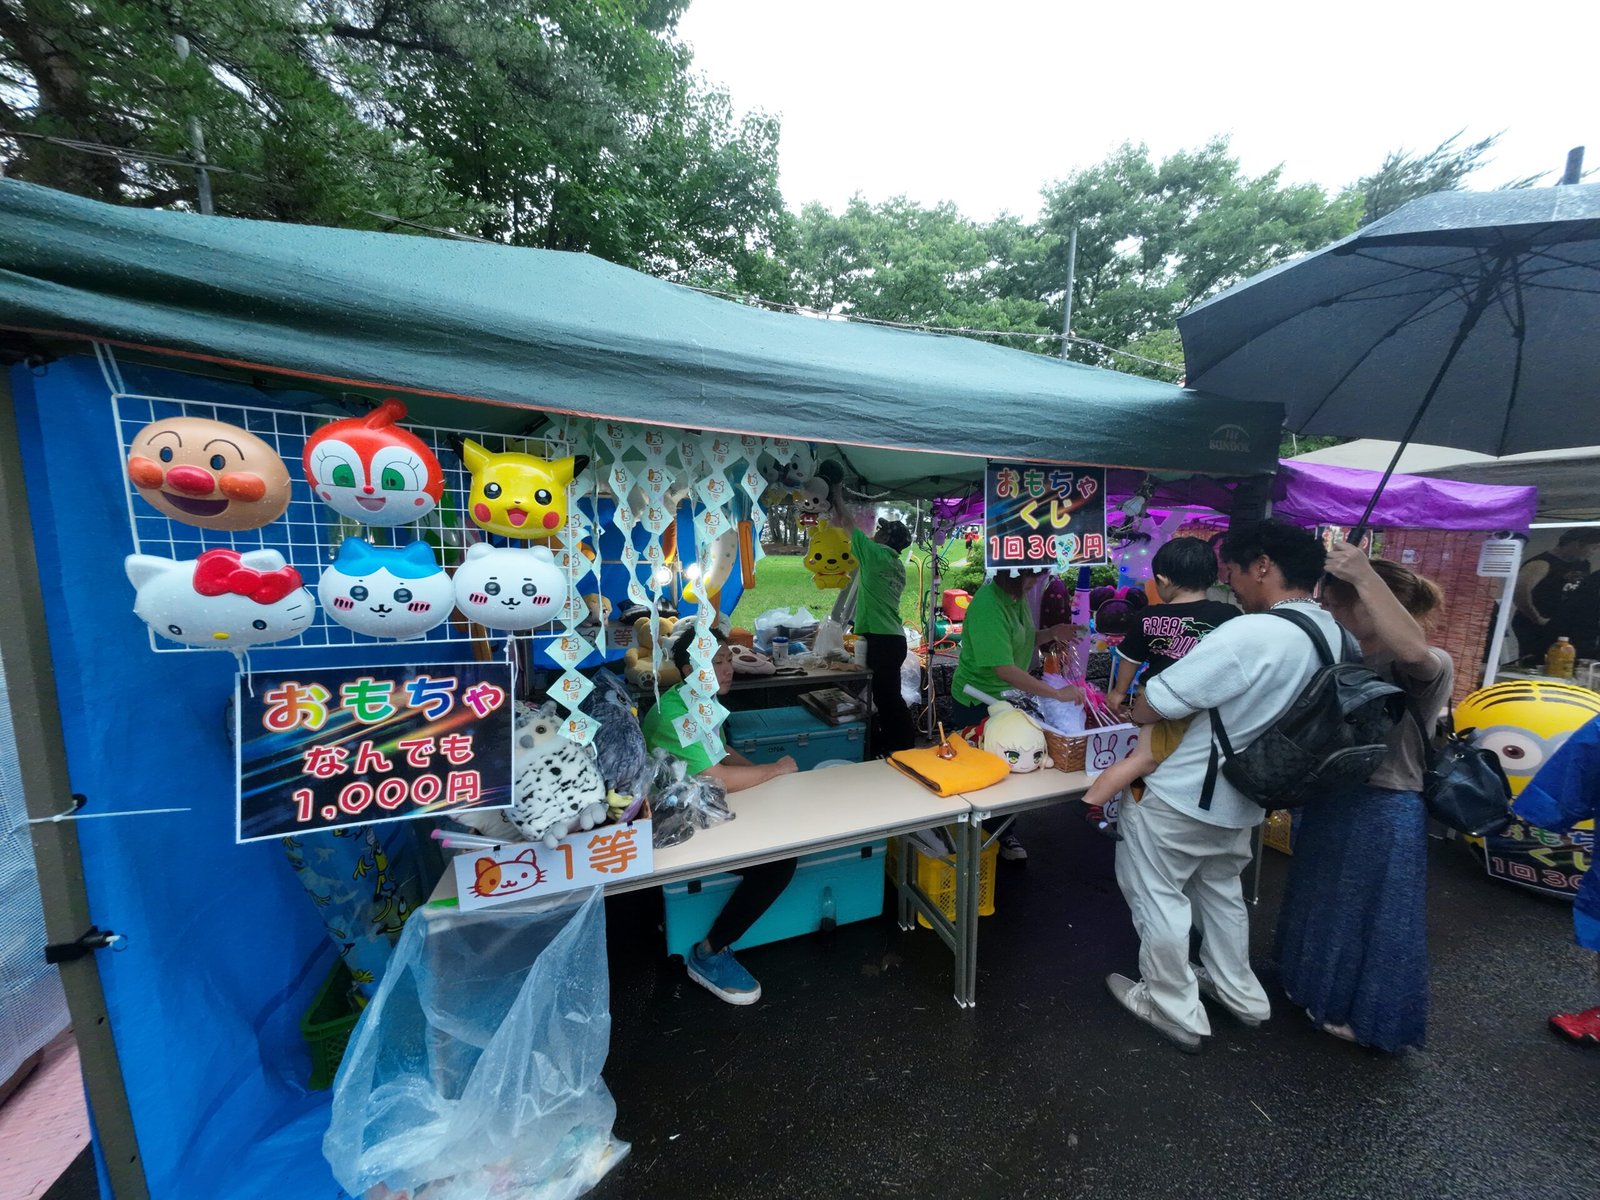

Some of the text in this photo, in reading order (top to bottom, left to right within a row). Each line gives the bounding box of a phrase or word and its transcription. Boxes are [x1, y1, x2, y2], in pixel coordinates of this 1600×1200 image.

[997, 467, 1098, 499] おもちゃ
[1019, 498, 1072, 530] くじ
[263, 674, 505, 732] おもちゃ
[303, 733, 475, 779] なんでも
[292, 769, 482, 822] 1,000円
[555, 829, 637, 881] 1等
